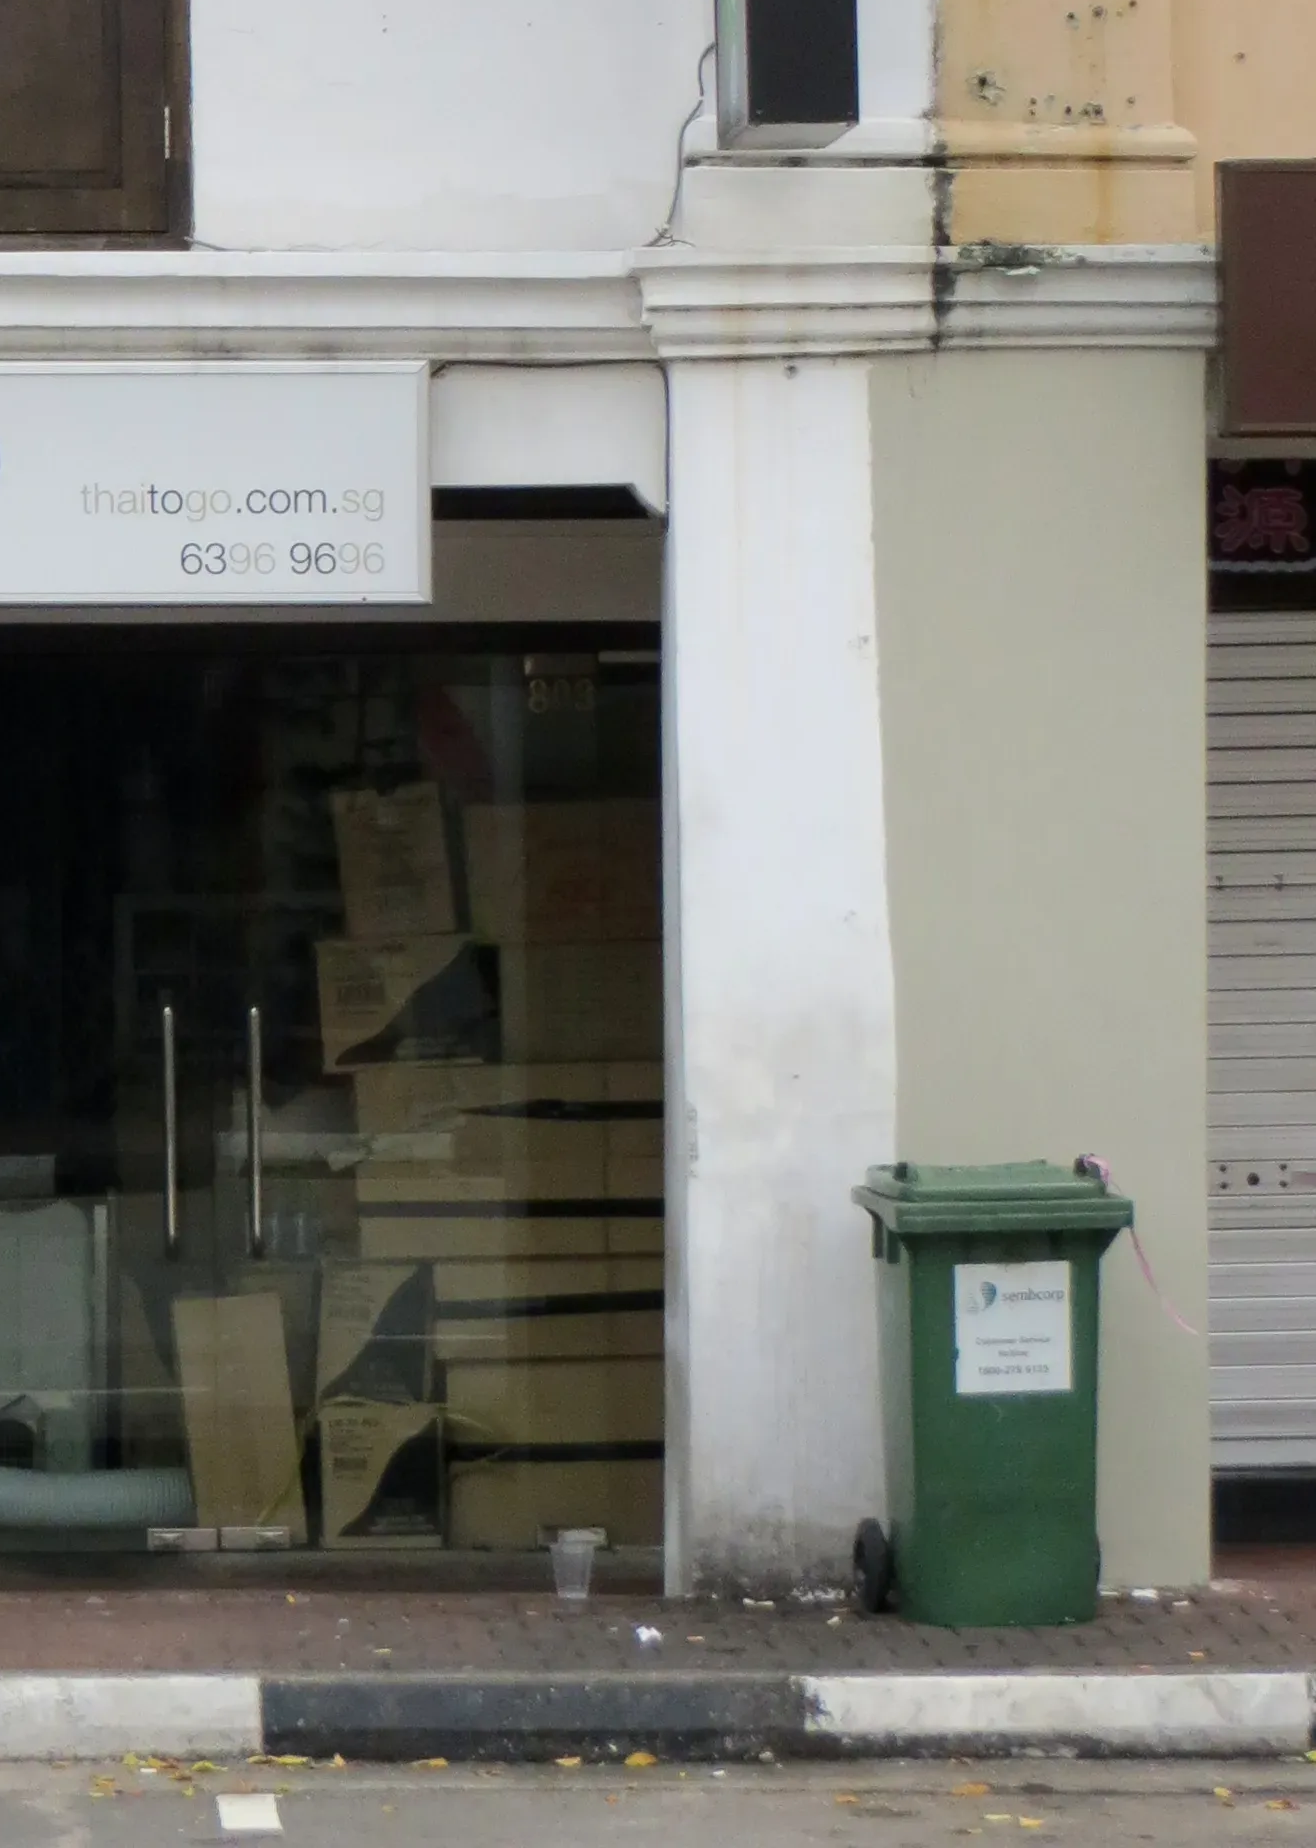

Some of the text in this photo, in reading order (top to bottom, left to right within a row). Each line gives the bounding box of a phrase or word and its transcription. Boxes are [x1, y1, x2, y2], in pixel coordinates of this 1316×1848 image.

[81, 483, 385, 522] thaitogo.com.sg
[180, 542, 385, 575] 6396 9696
[1001, 1287, 1065, 1304] sembcorp
